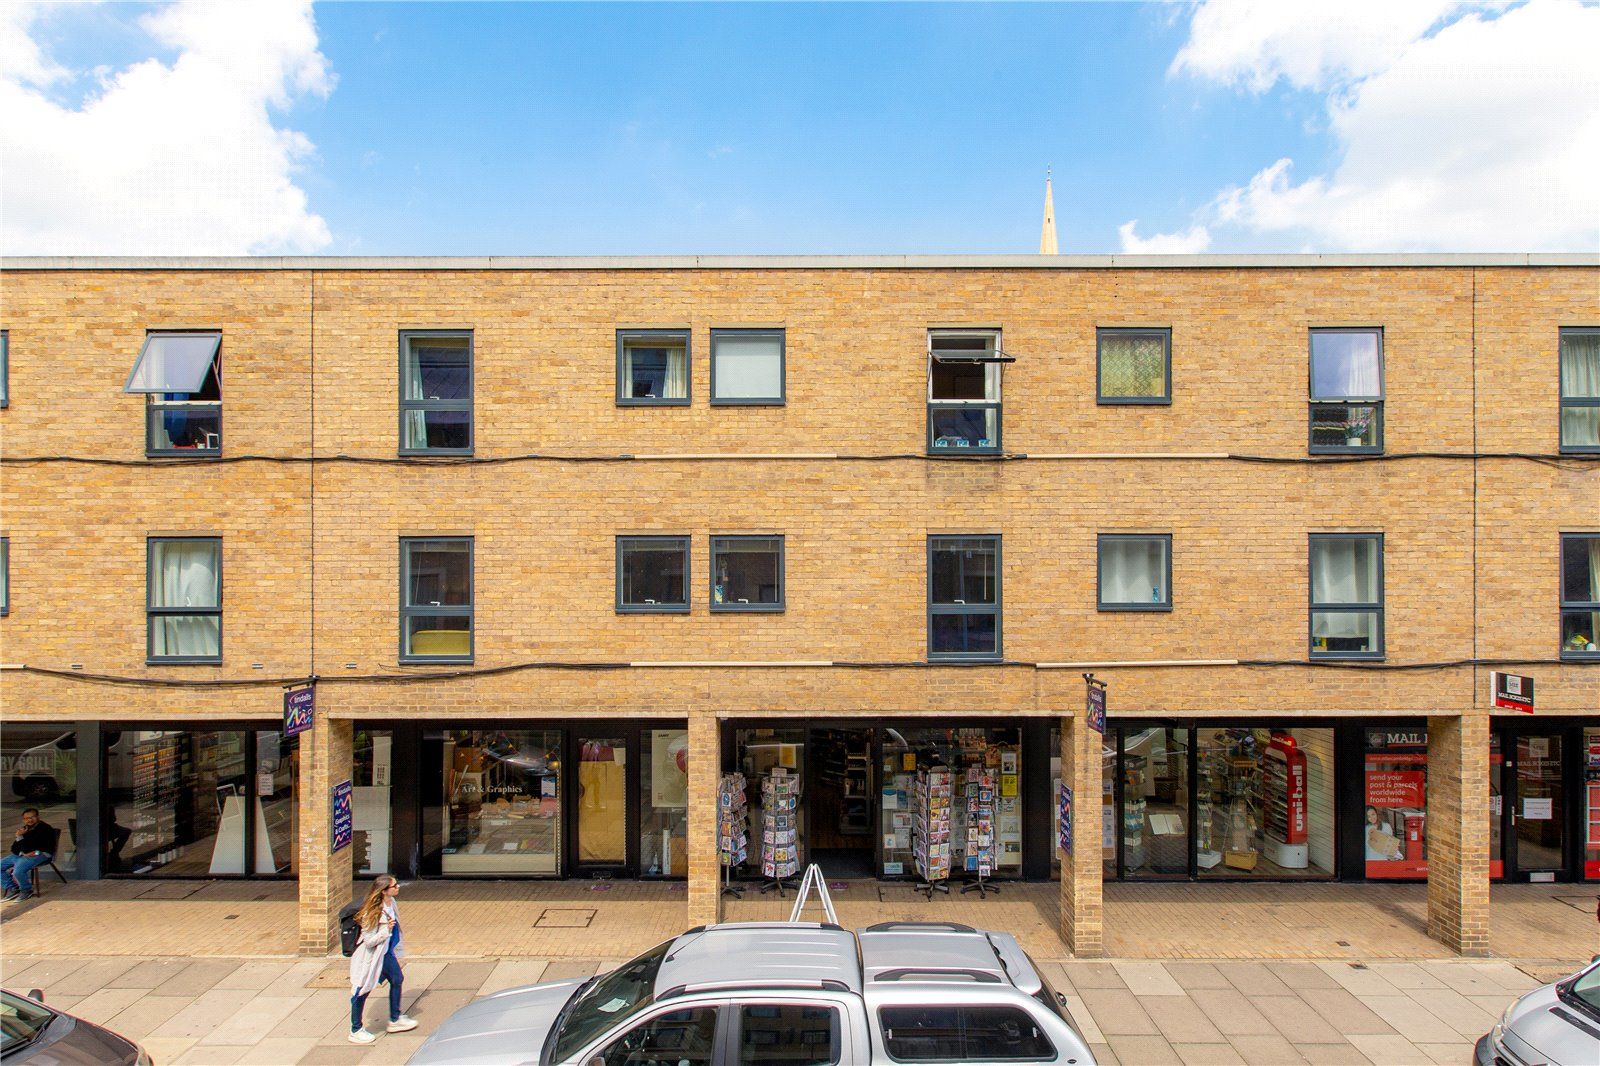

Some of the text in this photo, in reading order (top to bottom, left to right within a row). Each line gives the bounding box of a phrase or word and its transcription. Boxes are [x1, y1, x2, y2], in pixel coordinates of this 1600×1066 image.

[1387, 733, 1420, 744] MAIL
[487, 785, 523, 795] Graphics
[1292, 765, 1303, 832] uni-ball
